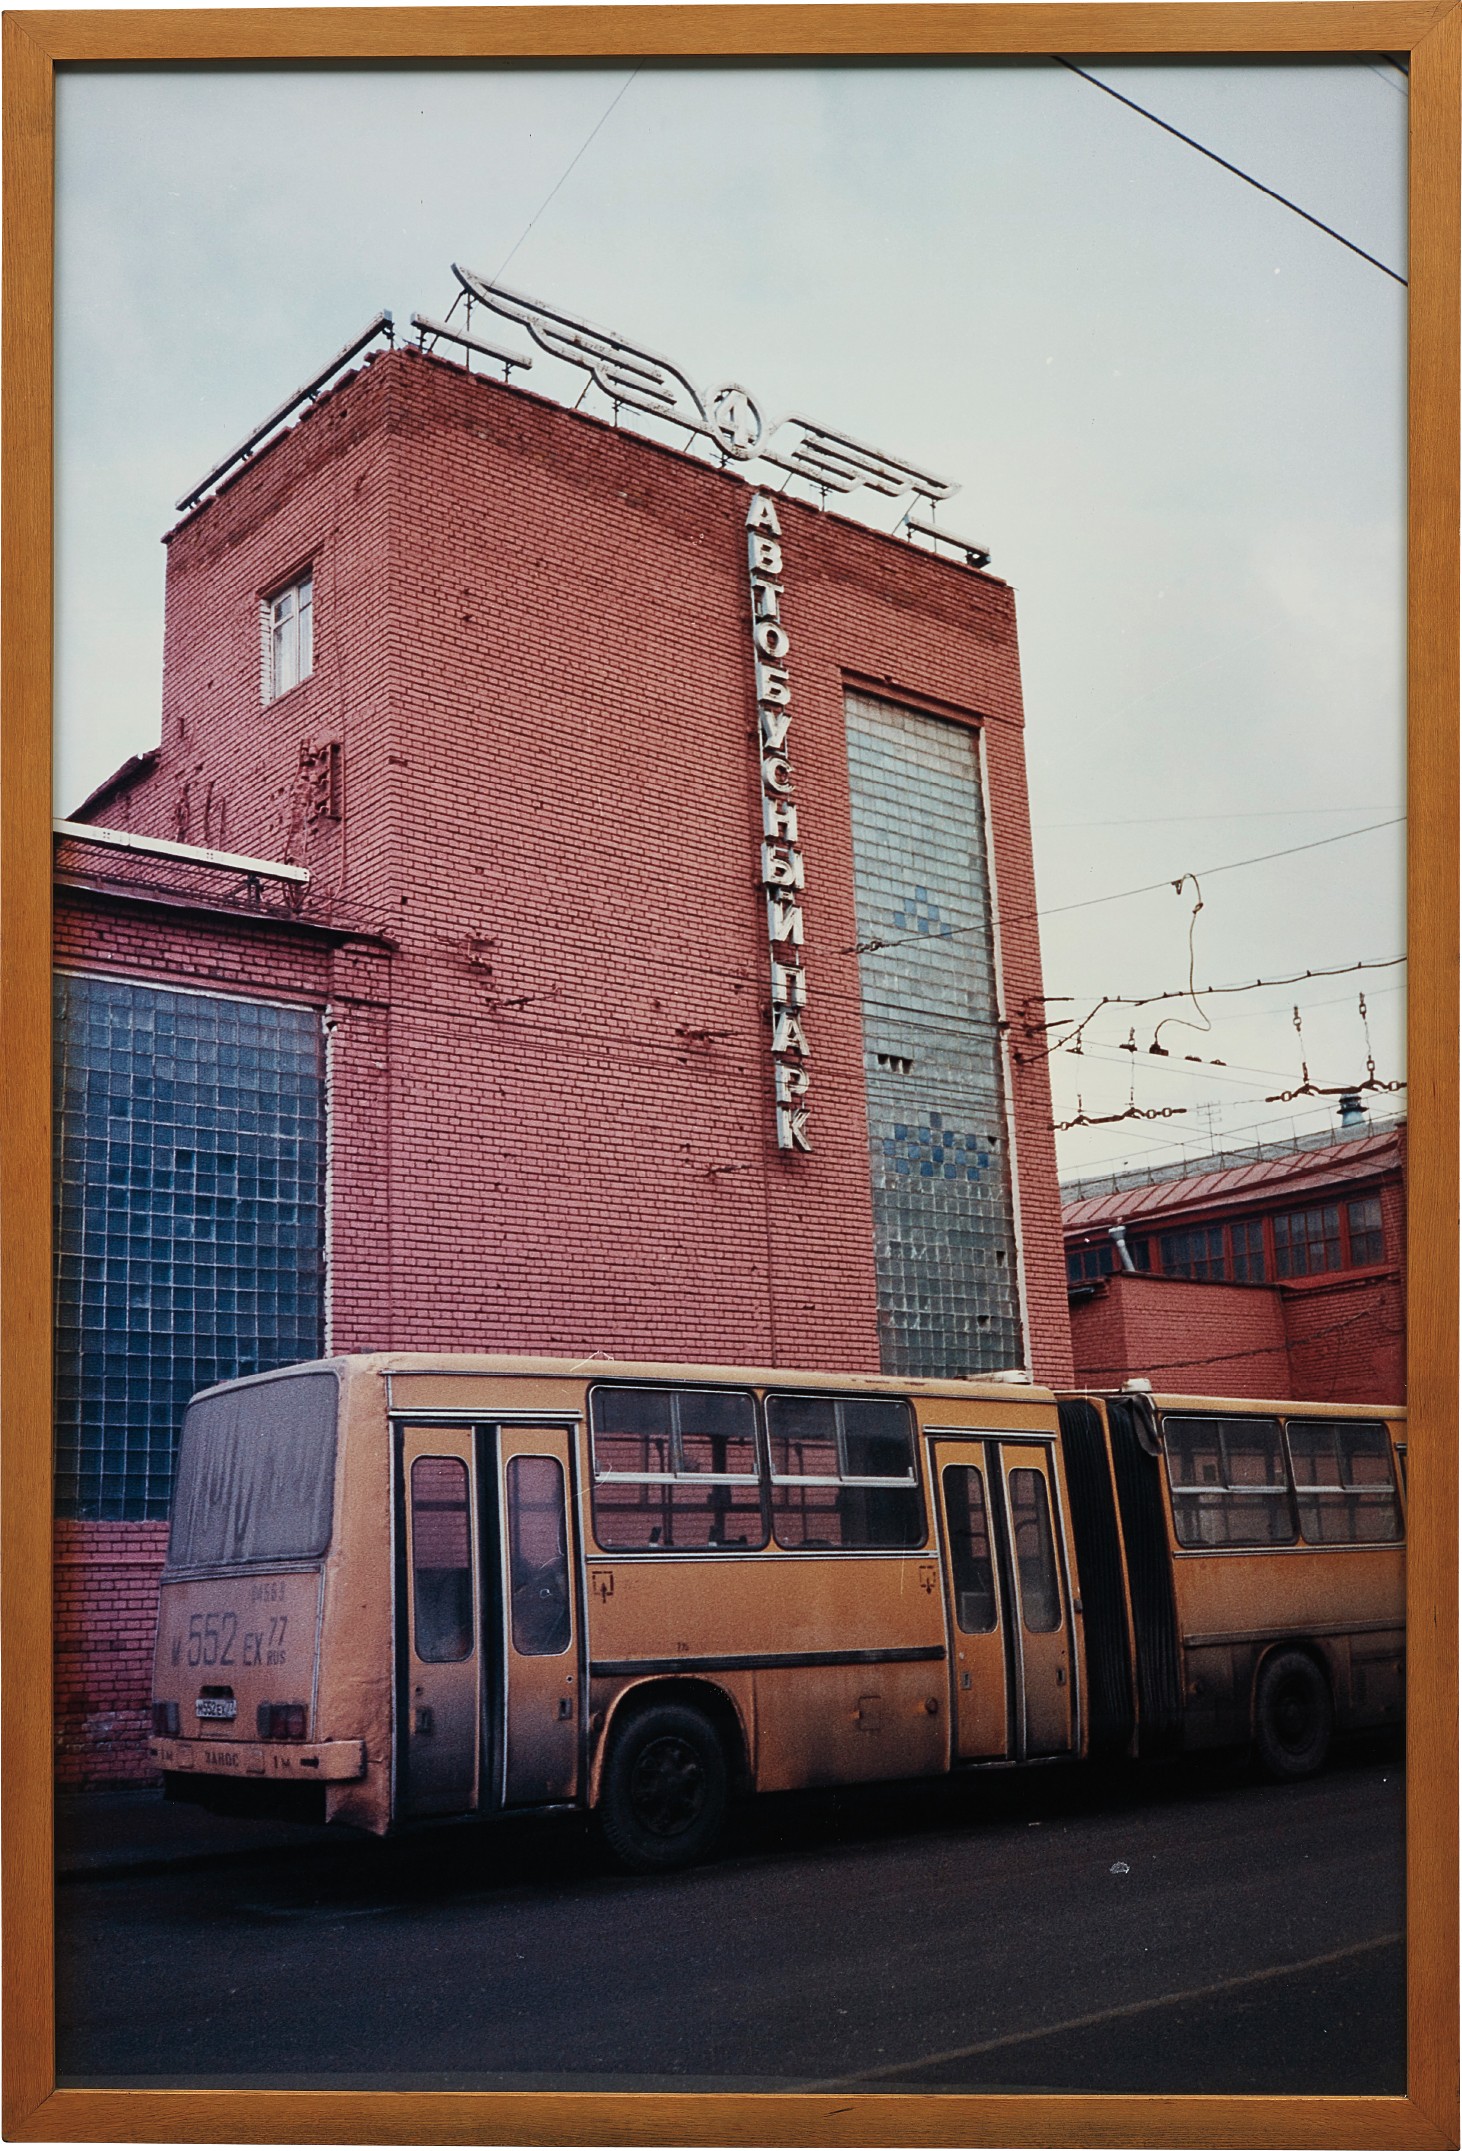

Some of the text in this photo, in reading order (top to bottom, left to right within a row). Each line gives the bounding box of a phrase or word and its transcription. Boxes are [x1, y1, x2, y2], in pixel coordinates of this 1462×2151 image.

[713, 389, 748, 445] 4
[745, 491, 813, 1154] АВТОБУСНЫЙ ПАРК
[187, 1611, 238, 1667] 552
[267, 1650, 286, 1665] RUS
[268, 1615, 288, 1646] 77
